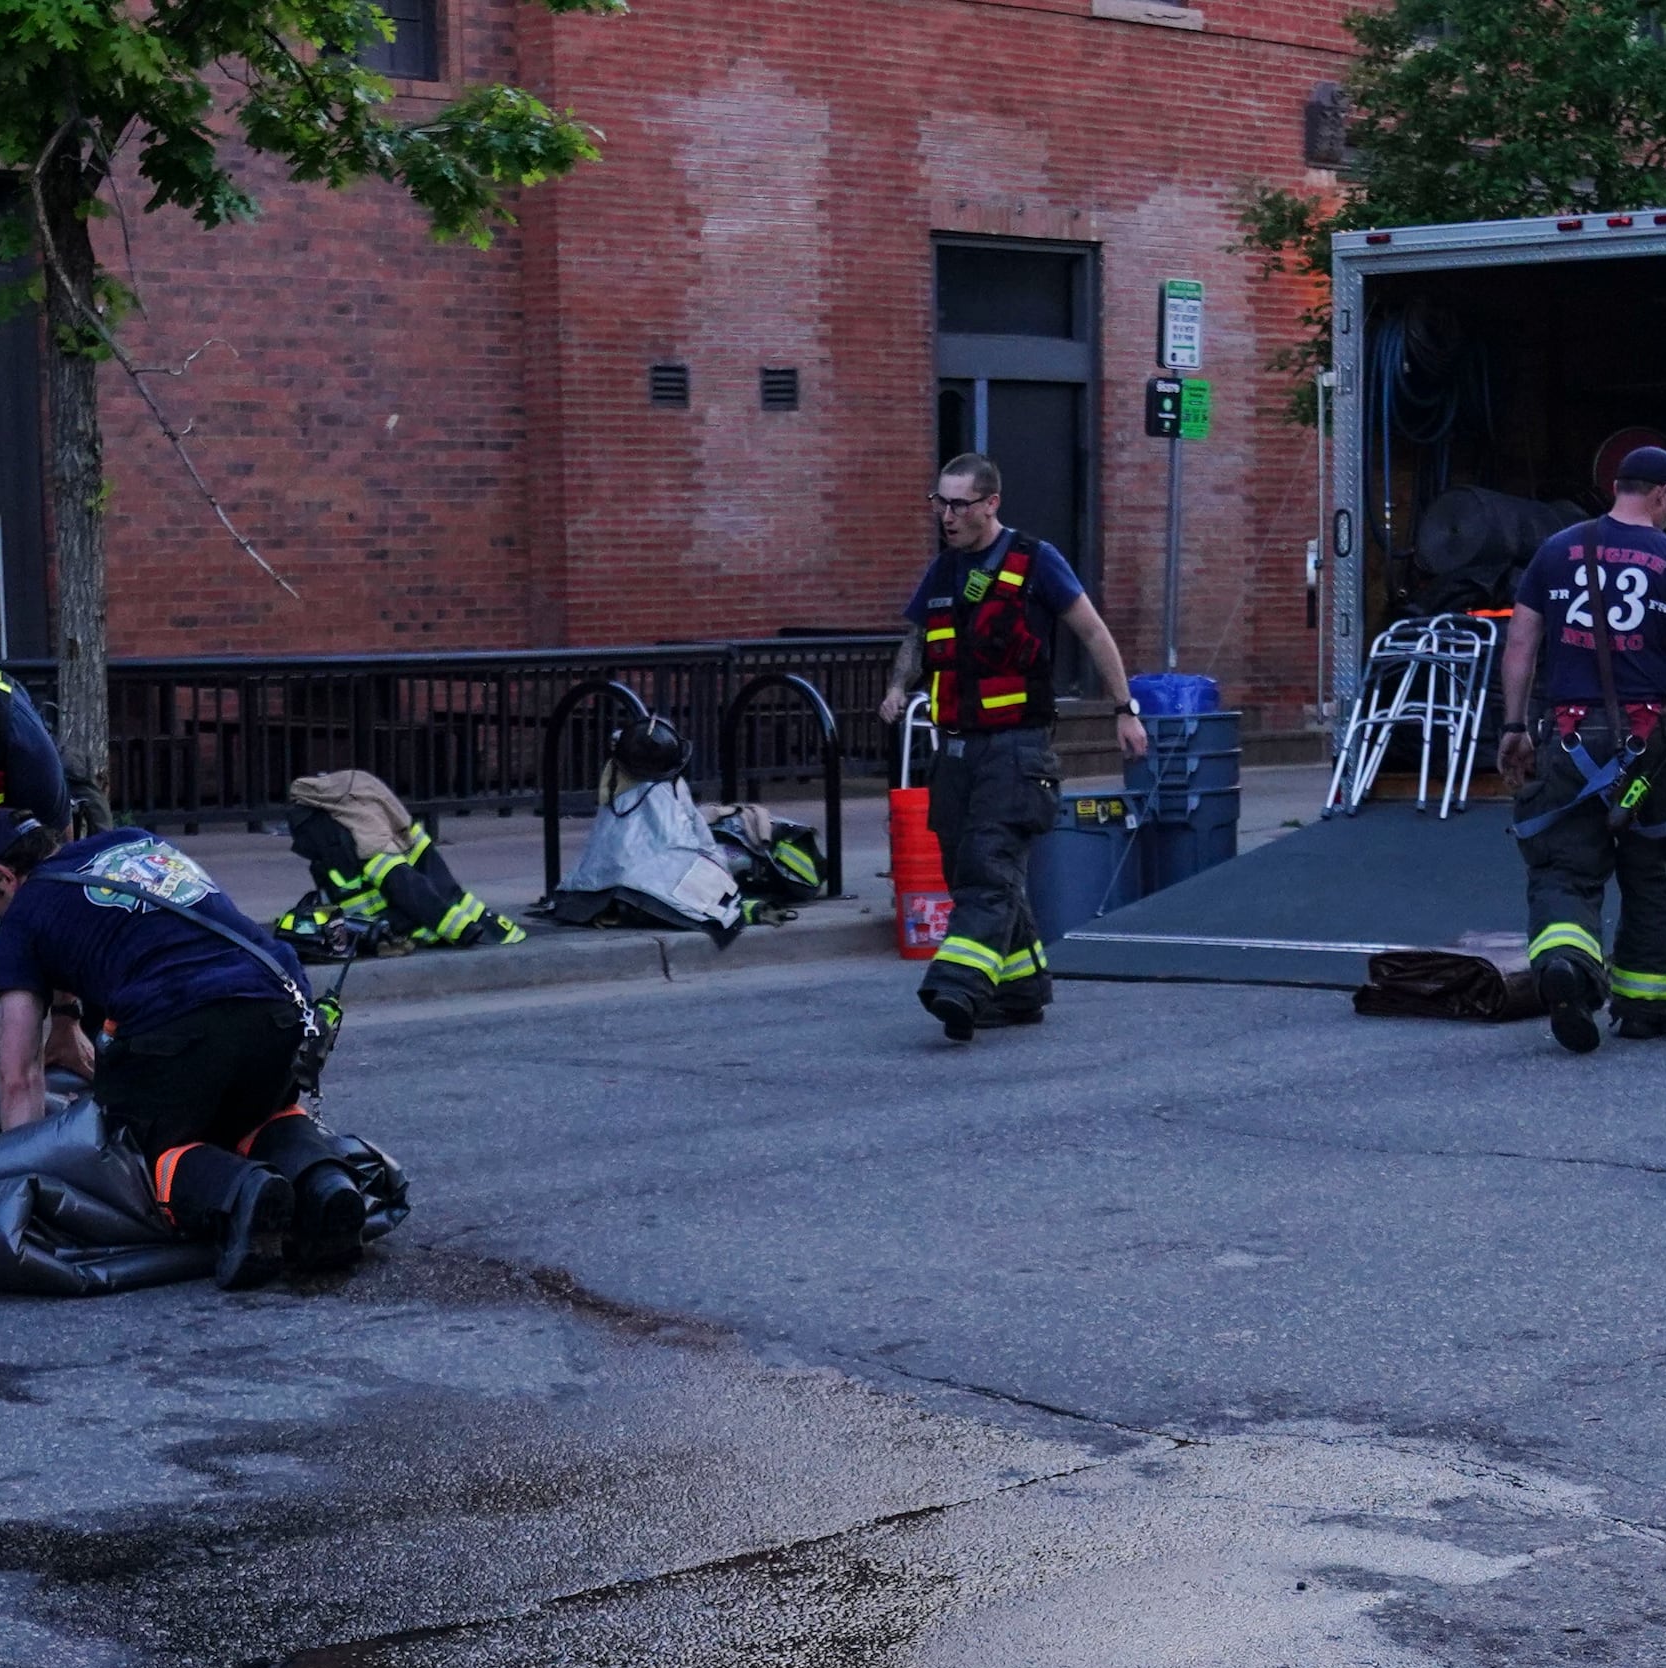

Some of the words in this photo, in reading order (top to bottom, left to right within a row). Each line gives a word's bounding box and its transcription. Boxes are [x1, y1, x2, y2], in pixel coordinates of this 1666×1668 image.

[1549, 588, 1570, 600] FR
[1565, 564, 1649, 631] 23
[1561, 627, 1644, 652] MEIC
